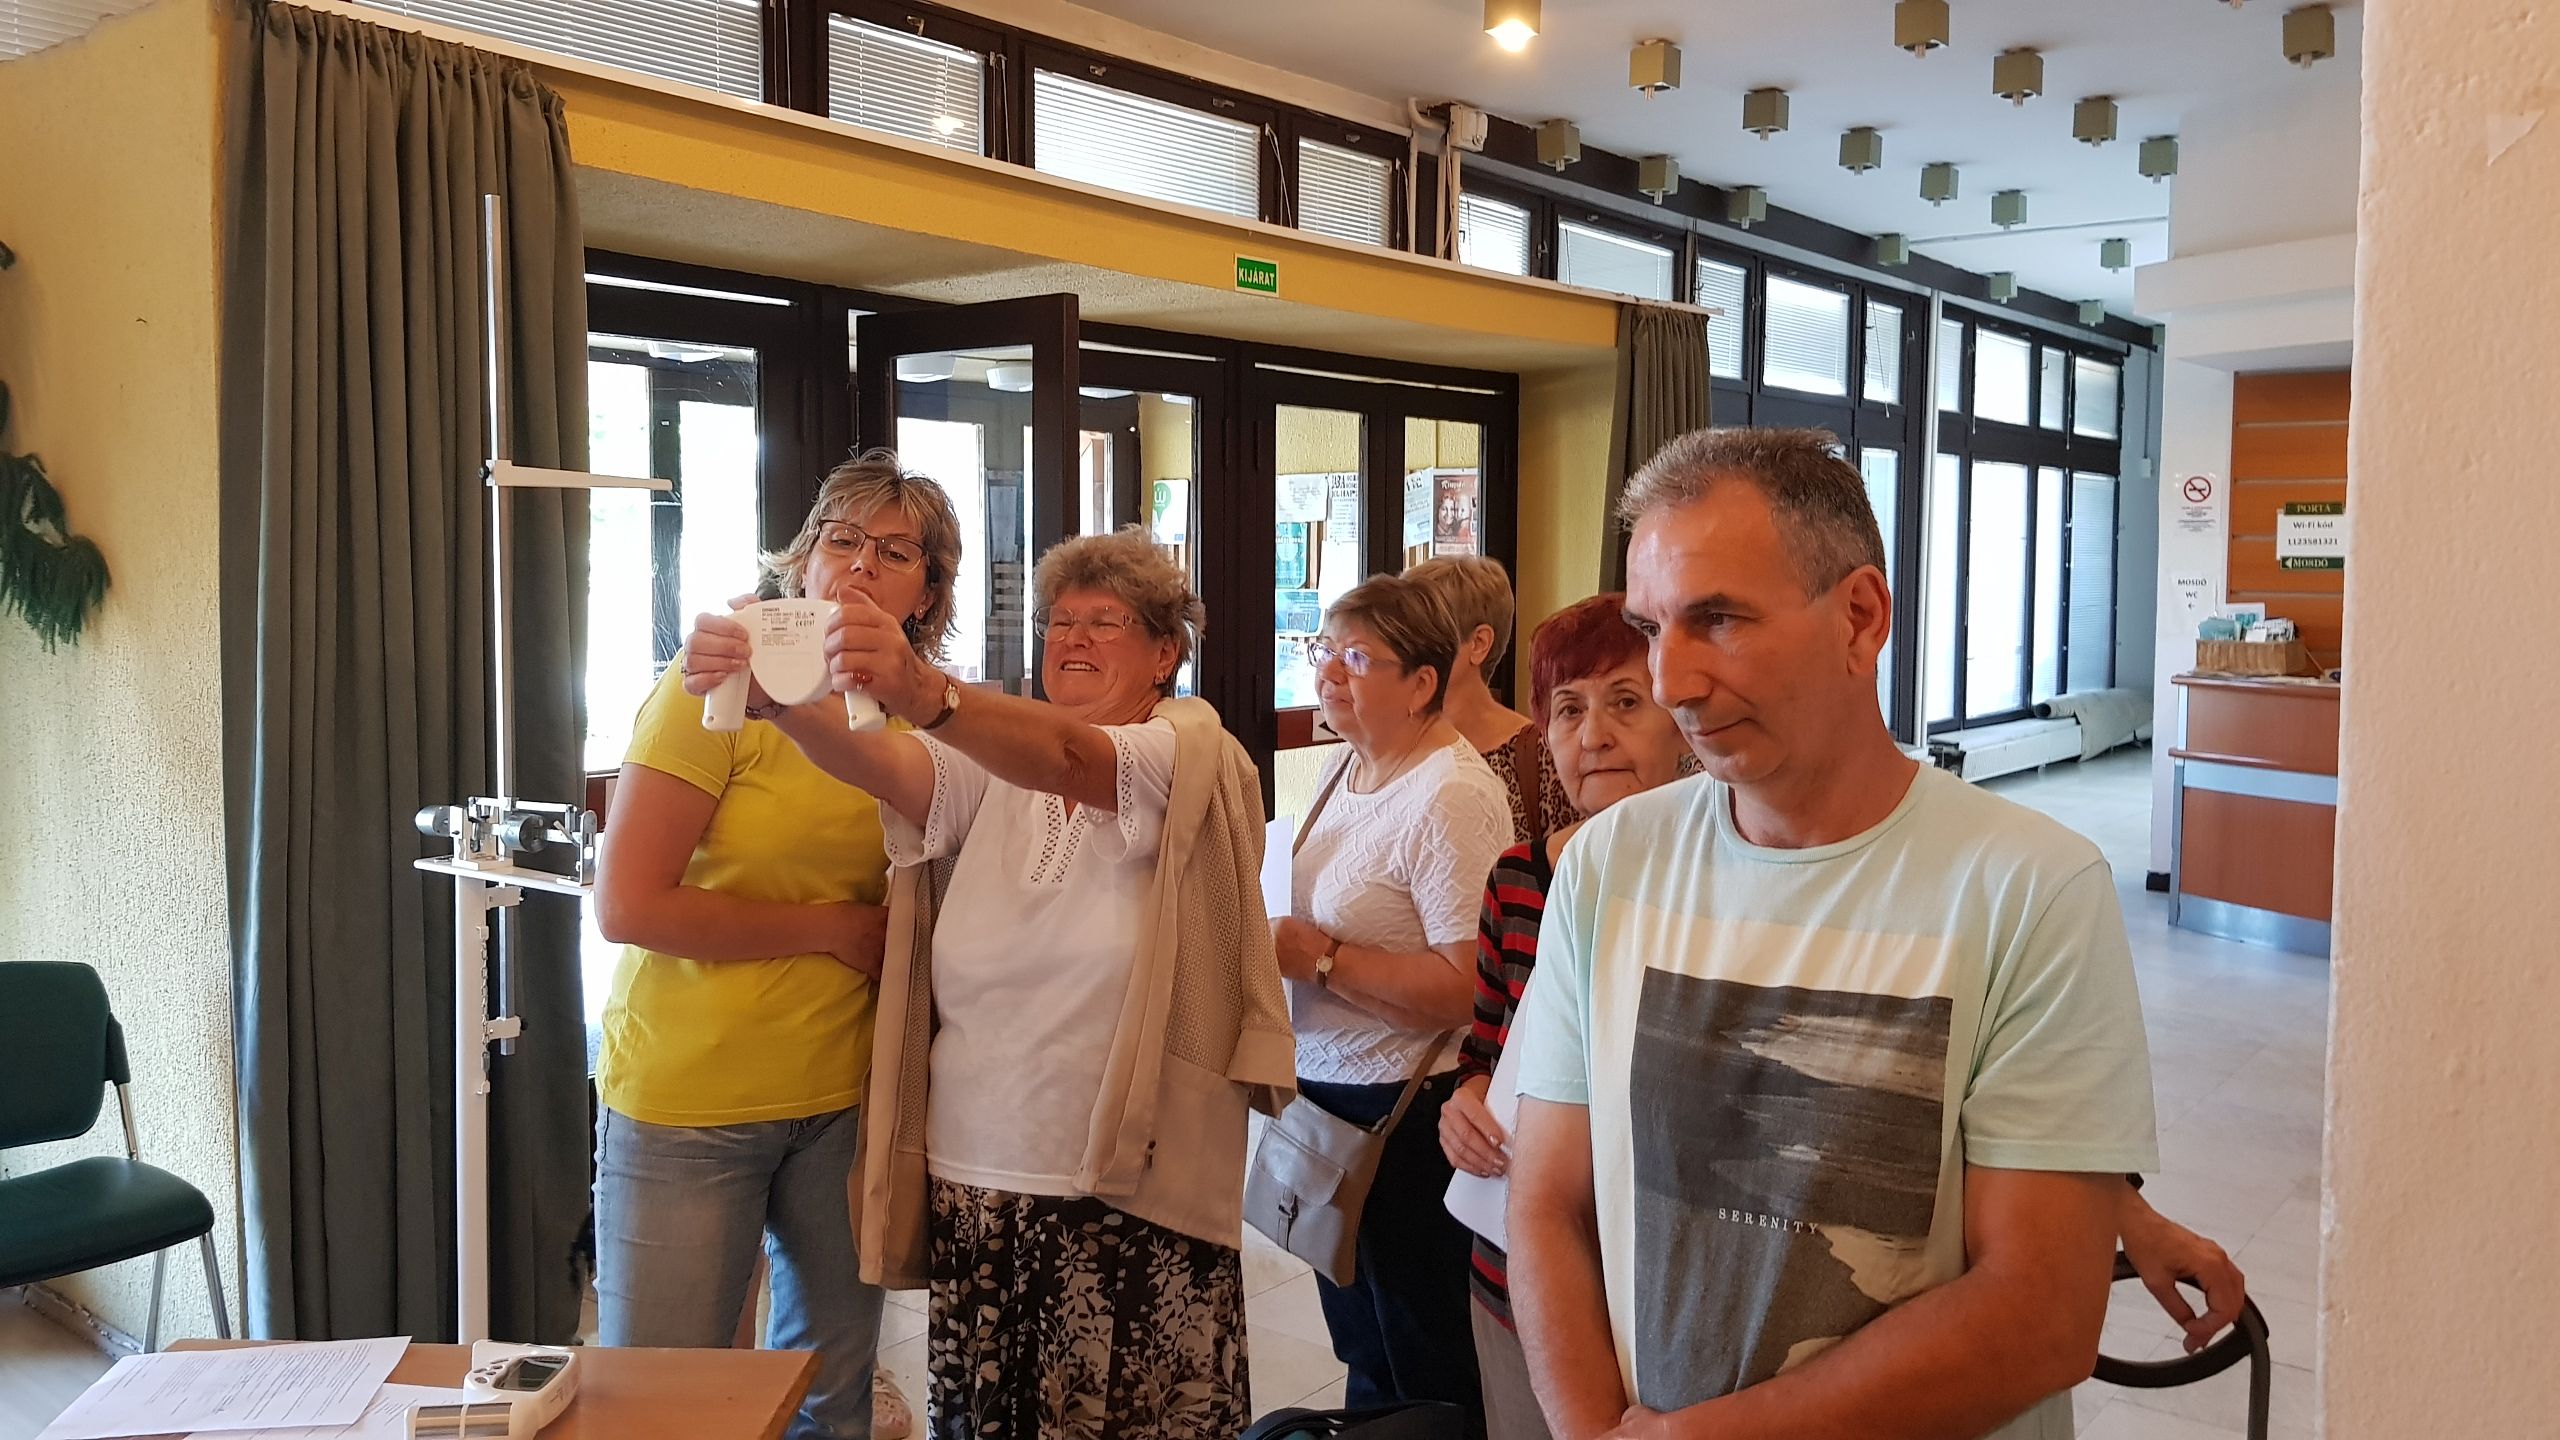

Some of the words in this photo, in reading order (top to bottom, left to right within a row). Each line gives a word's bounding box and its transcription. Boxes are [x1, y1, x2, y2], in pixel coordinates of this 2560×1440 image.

[1238, 267, 1275, 287] KIJÁRAT
[2297, 504, 2331, 513] PORTA
[2293, 521, 2315, 529] Wi-Fi
[2317, 520, 2333, 528] kód
[2178, 578, 2207, 587] MOSDÓ
[2185, 591, 2198, 599] WC
[1718, 1207, 1819, 1235] SERENITY
